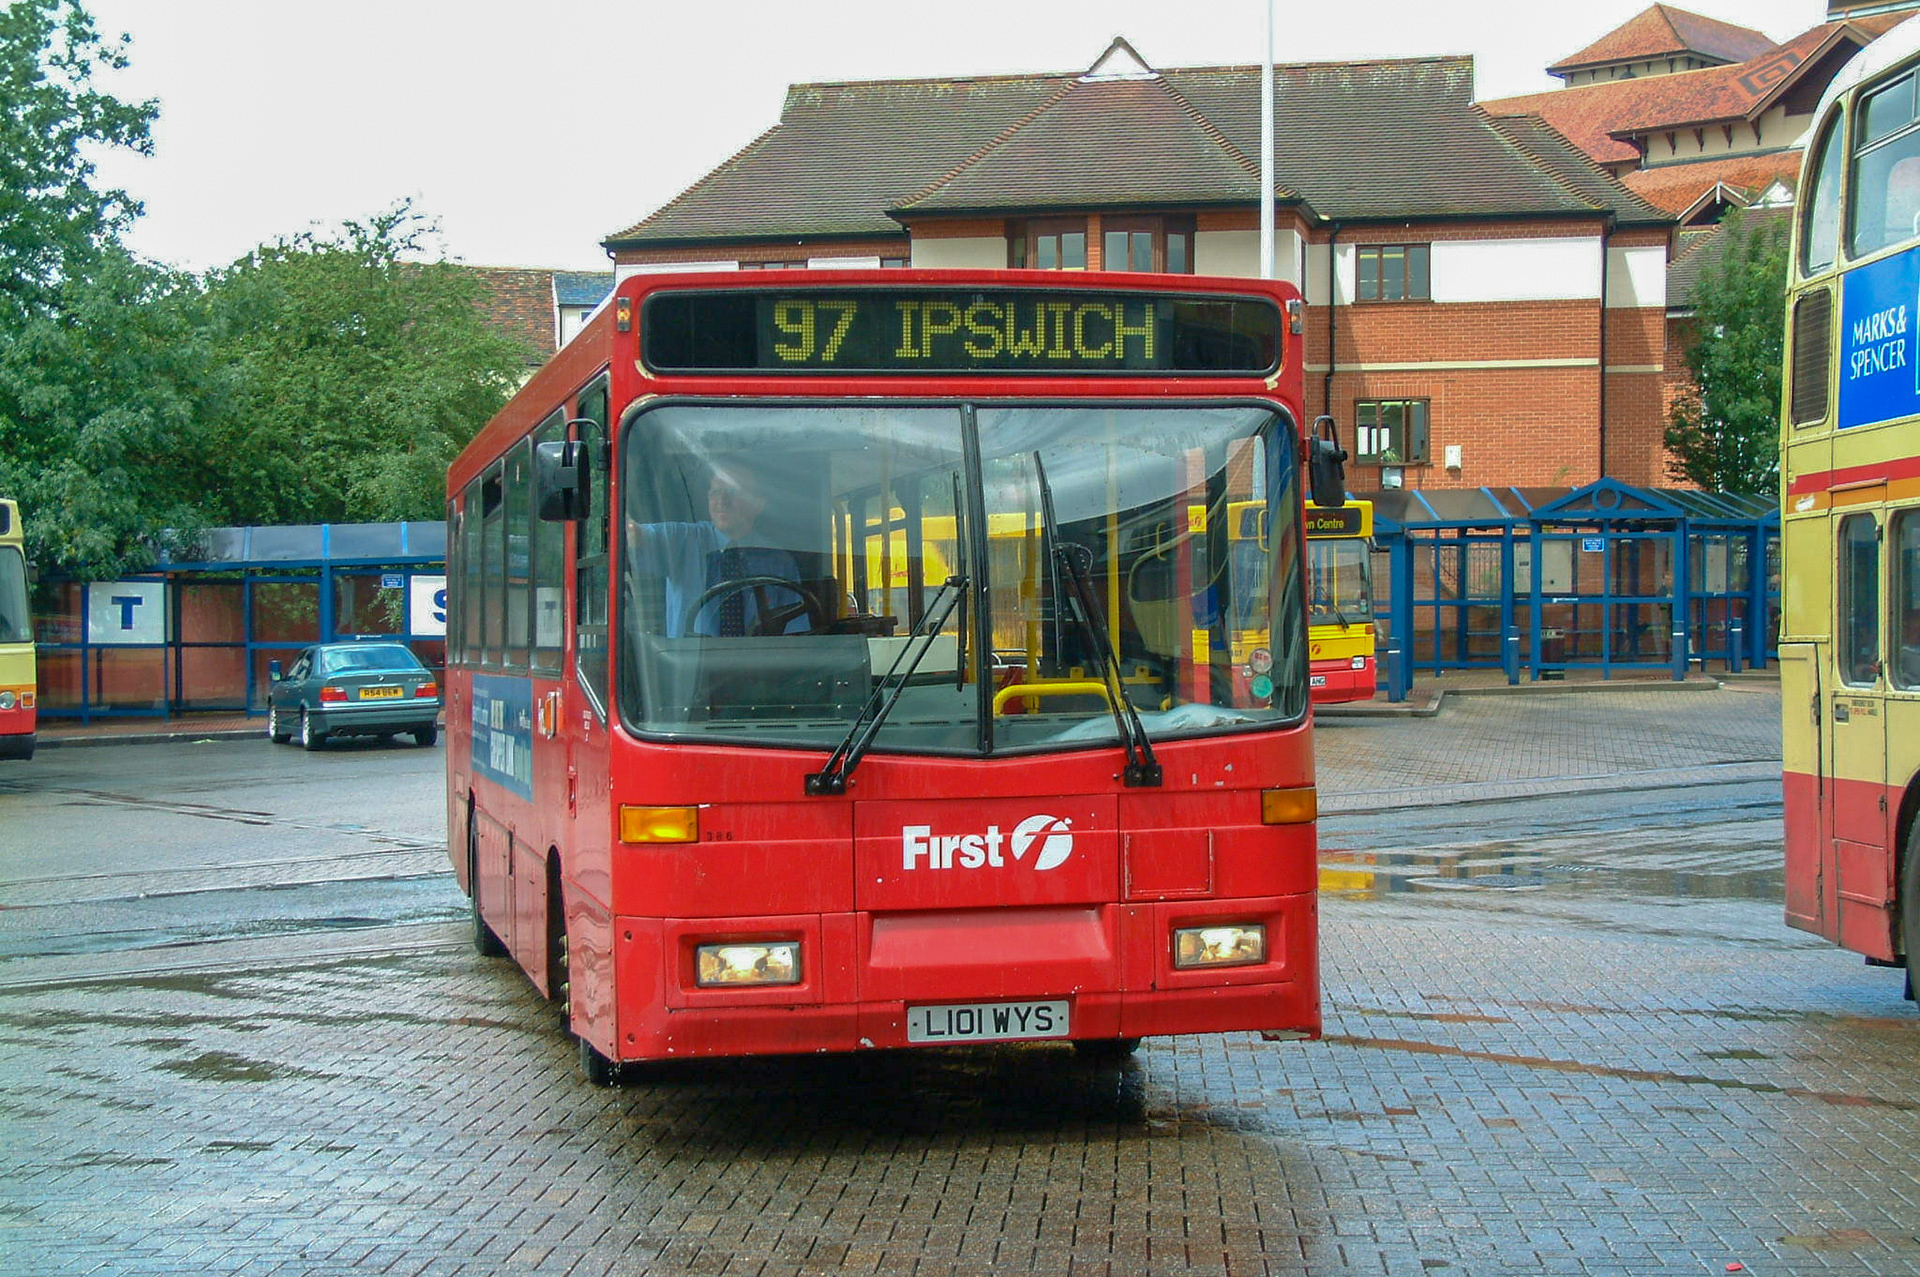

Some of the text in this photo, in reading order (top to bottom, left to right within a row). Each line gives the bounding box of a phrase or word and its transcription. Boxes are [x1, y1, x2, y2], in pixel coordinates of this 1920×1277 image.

[774, 300, 1154, 361] 97 IPSWICH
[1850, 338, 1906, 380] SPENCER
[1317, 518, 1345, 529] Centre
[111, 596, 143, 630] T
[902, 825, 1004, 870] First
[926, 1005, 1053, 1037] L101 WYS
